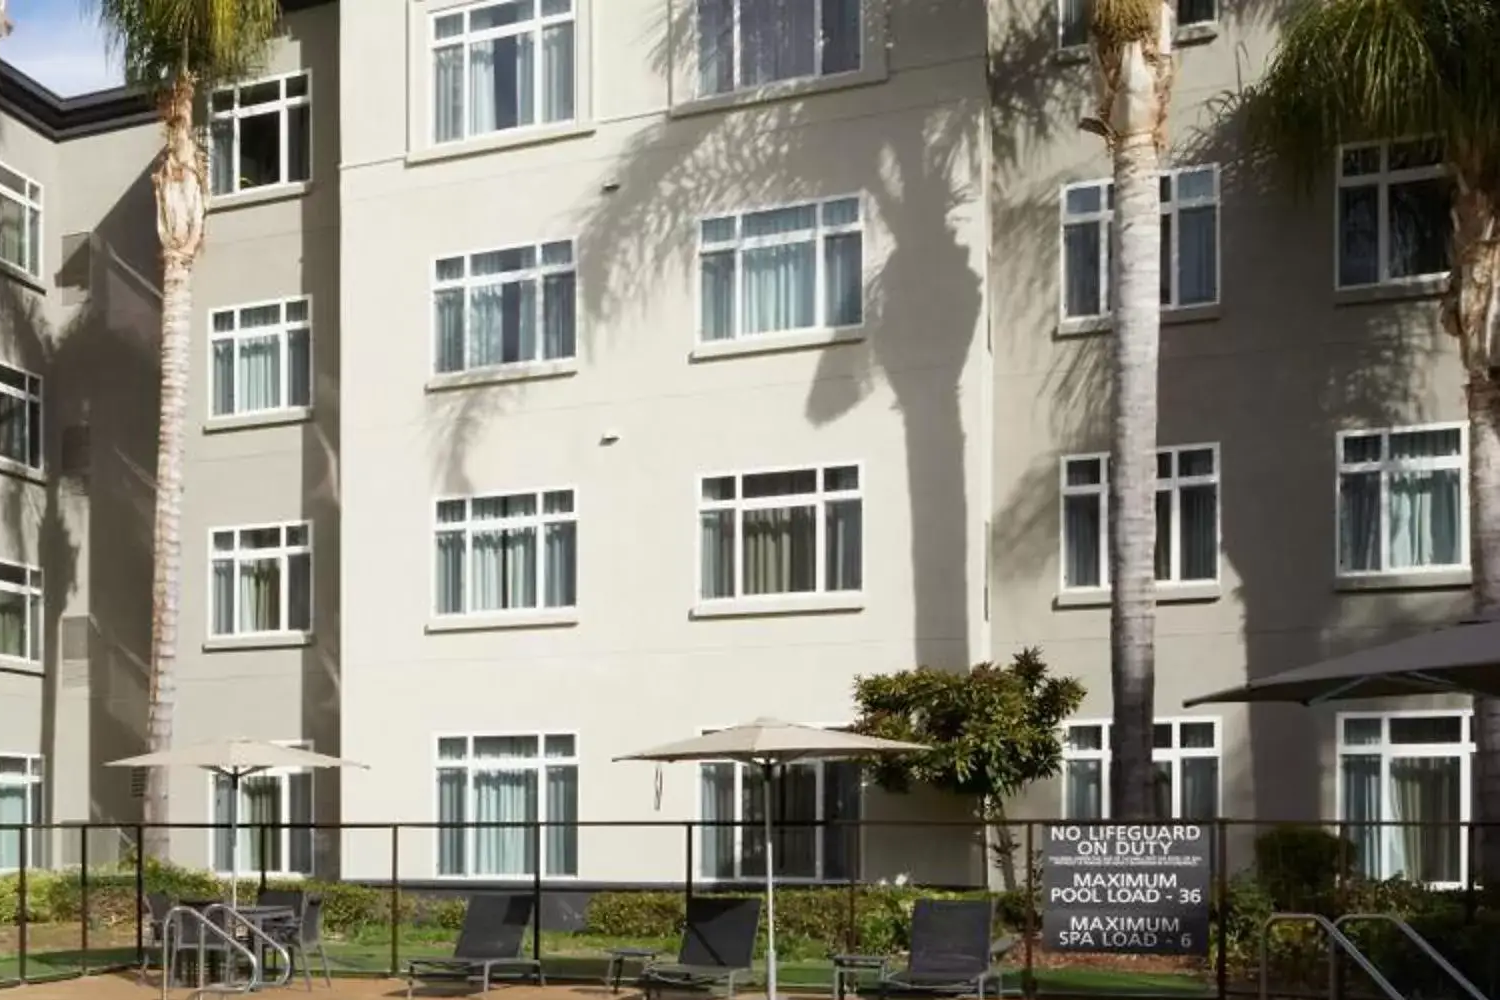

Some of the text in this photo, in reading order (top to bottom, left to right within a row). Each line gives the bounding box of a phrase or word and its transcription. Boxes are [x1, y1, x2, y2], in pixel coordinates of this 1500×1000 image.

[1051, 825, 1202, 841] NO LIFEGUARD
[1077, 841, 1173, 856] ON DUTY
[1073, 873, 1177, 888] MAXIMUM
[1051, 888, 1101, 903] POOL
[1107, 888, 1160, 903] LOAD
[1179, 888, 1202, 904] 36
[1070, 916, 1180, 932] MAXIMUM
[1059, 931, 1095, 946] SPA
[1102, 932, 1158, 947] LOAD
[1180, 932, 1192, 948] 6
